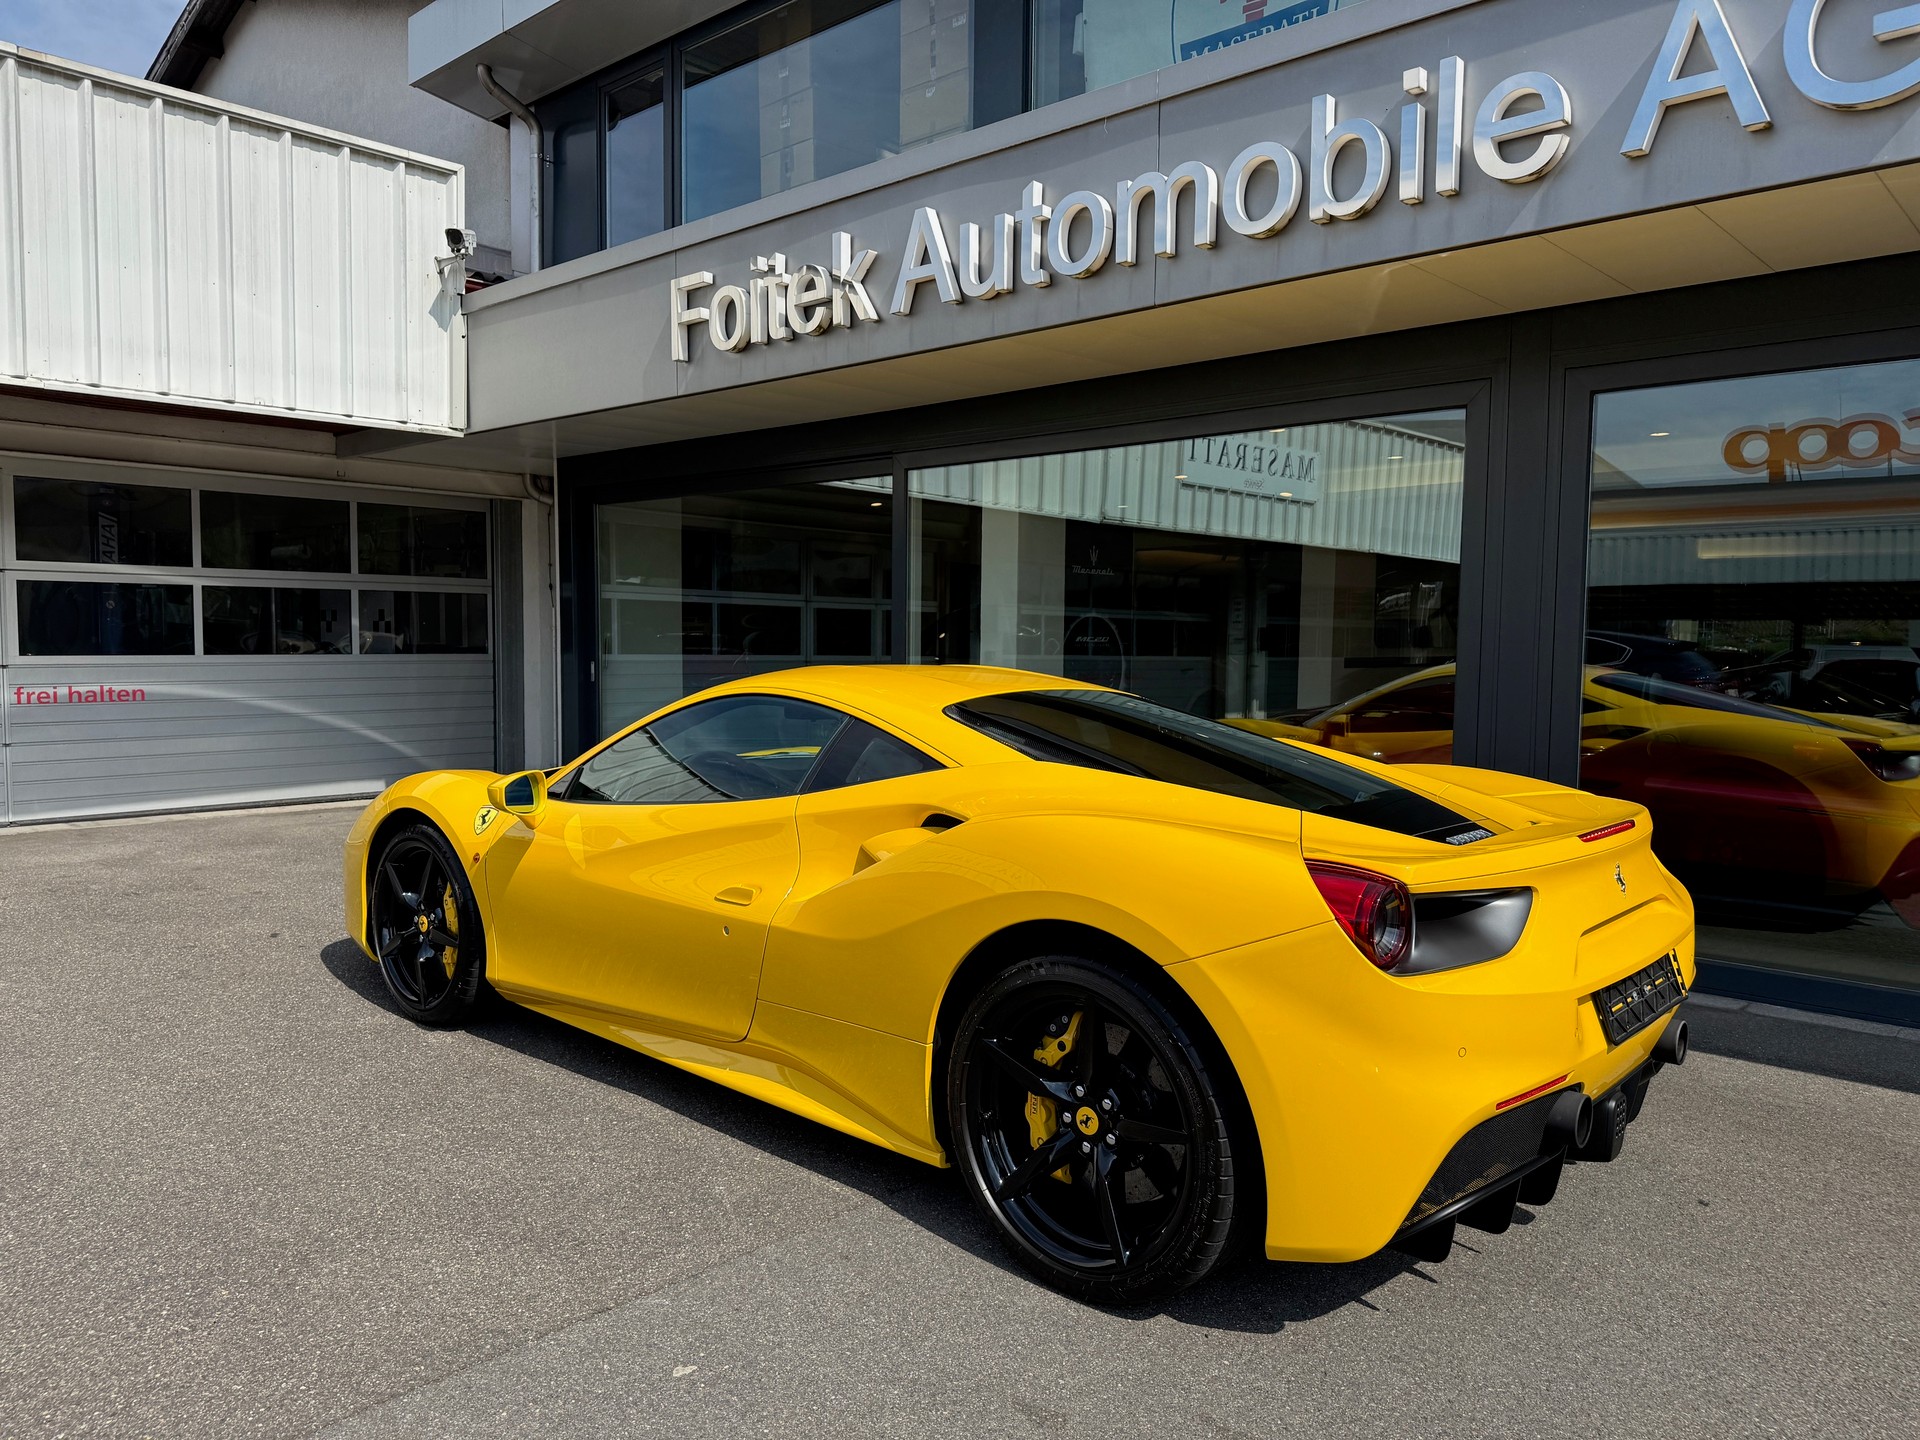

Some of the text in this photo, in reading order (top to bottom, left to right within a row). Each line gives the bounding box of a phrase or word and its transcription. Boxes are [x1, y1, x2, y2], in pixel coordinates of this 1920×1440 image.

[671, 0, 1920, 362] Foitek Automobile AG
[14, 685, 146, 705] frei halten
